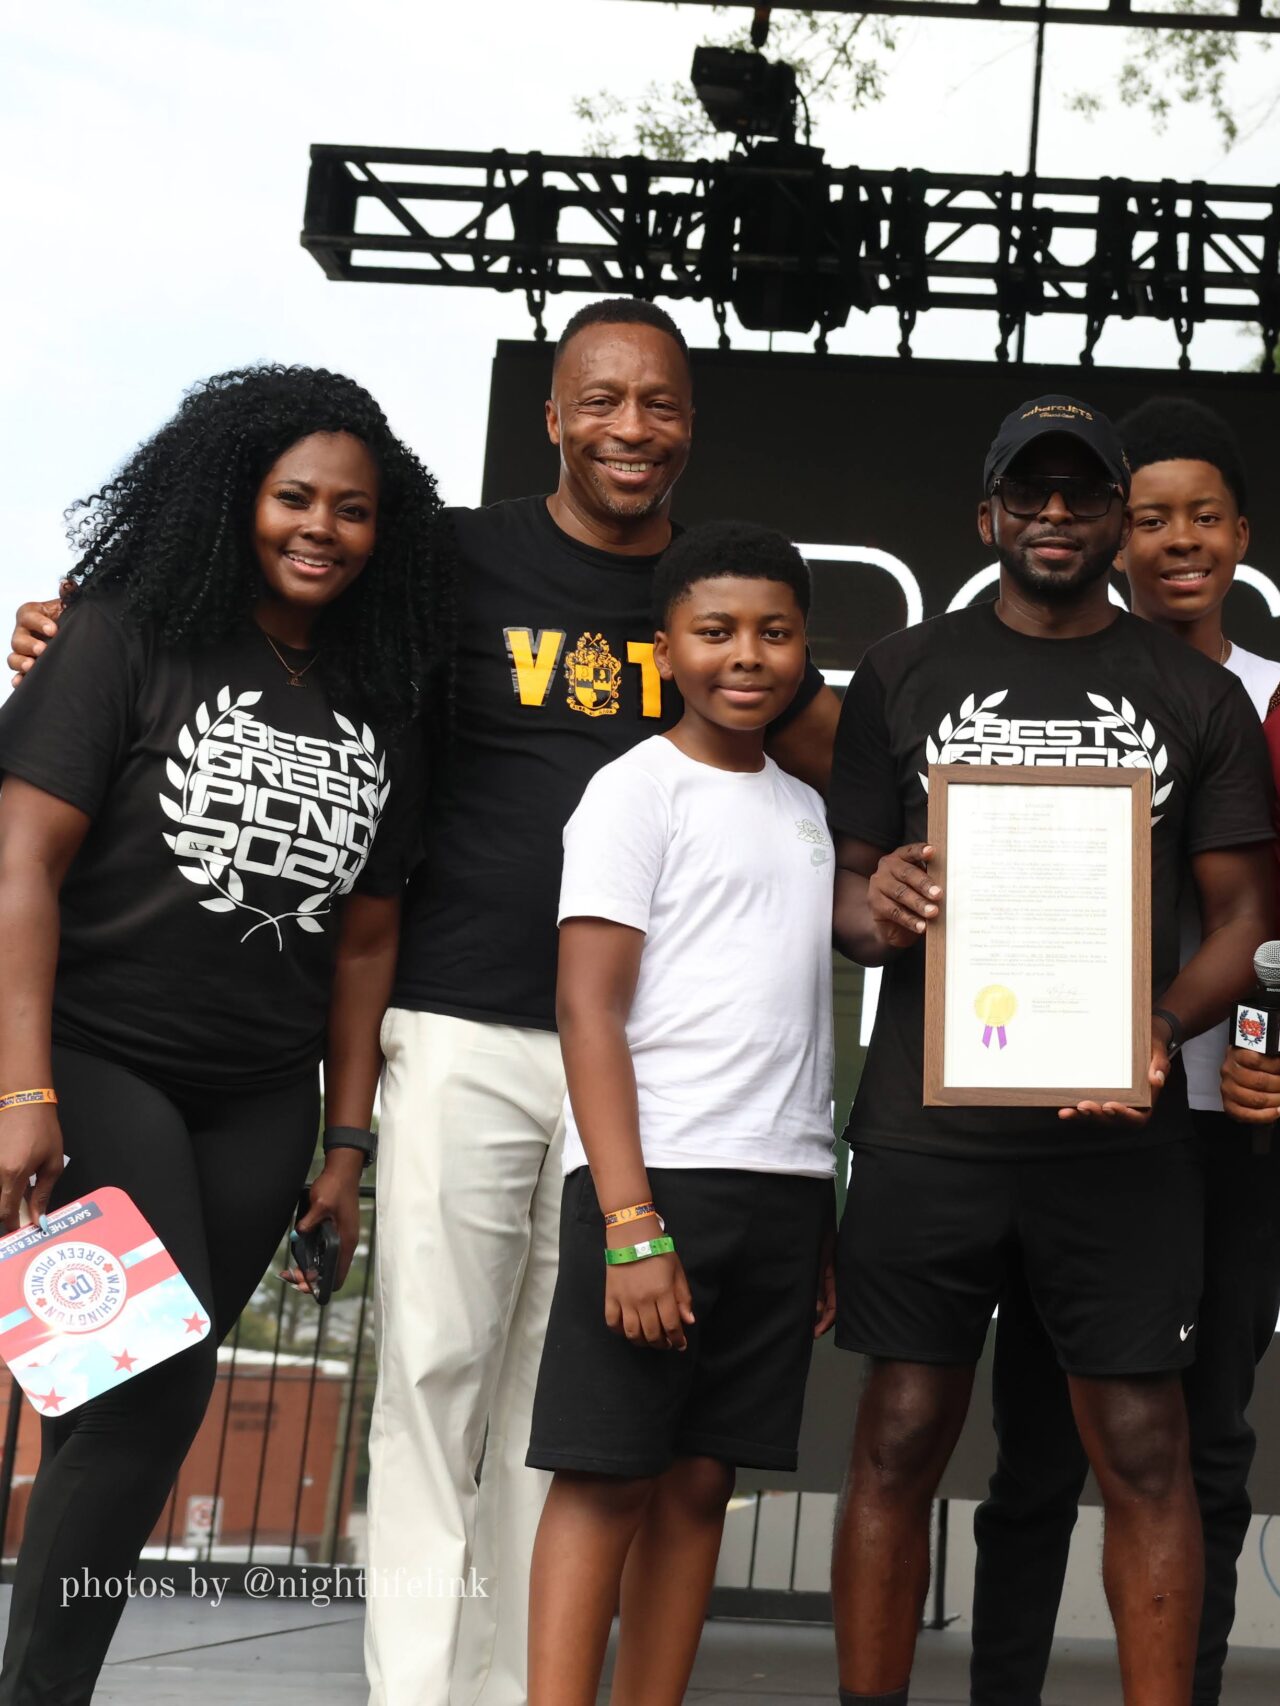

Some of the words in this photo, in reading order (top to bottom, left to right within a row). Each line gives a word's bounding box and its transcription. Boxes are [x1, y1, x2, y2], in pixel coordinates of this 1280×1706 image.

[233, 718, 365, 773] BEST
[973, 718, 1117, 747] BEST
[940, 744, 1151, 769] GREEK
[197, 738, 378, 820] GREEK
[188, 771, 373, 857] PICNIC
[48, 1223, 69, 1235] THE
[67, 1208, 92, 1225] SAVE
[25, 1229, 50, 1246] DATE
[57, 1247, 105, 1267] GREEK
[31, 1255, 57, 1296] PICNIC
[44, 1273, 121, 1327] WASHINGTON
